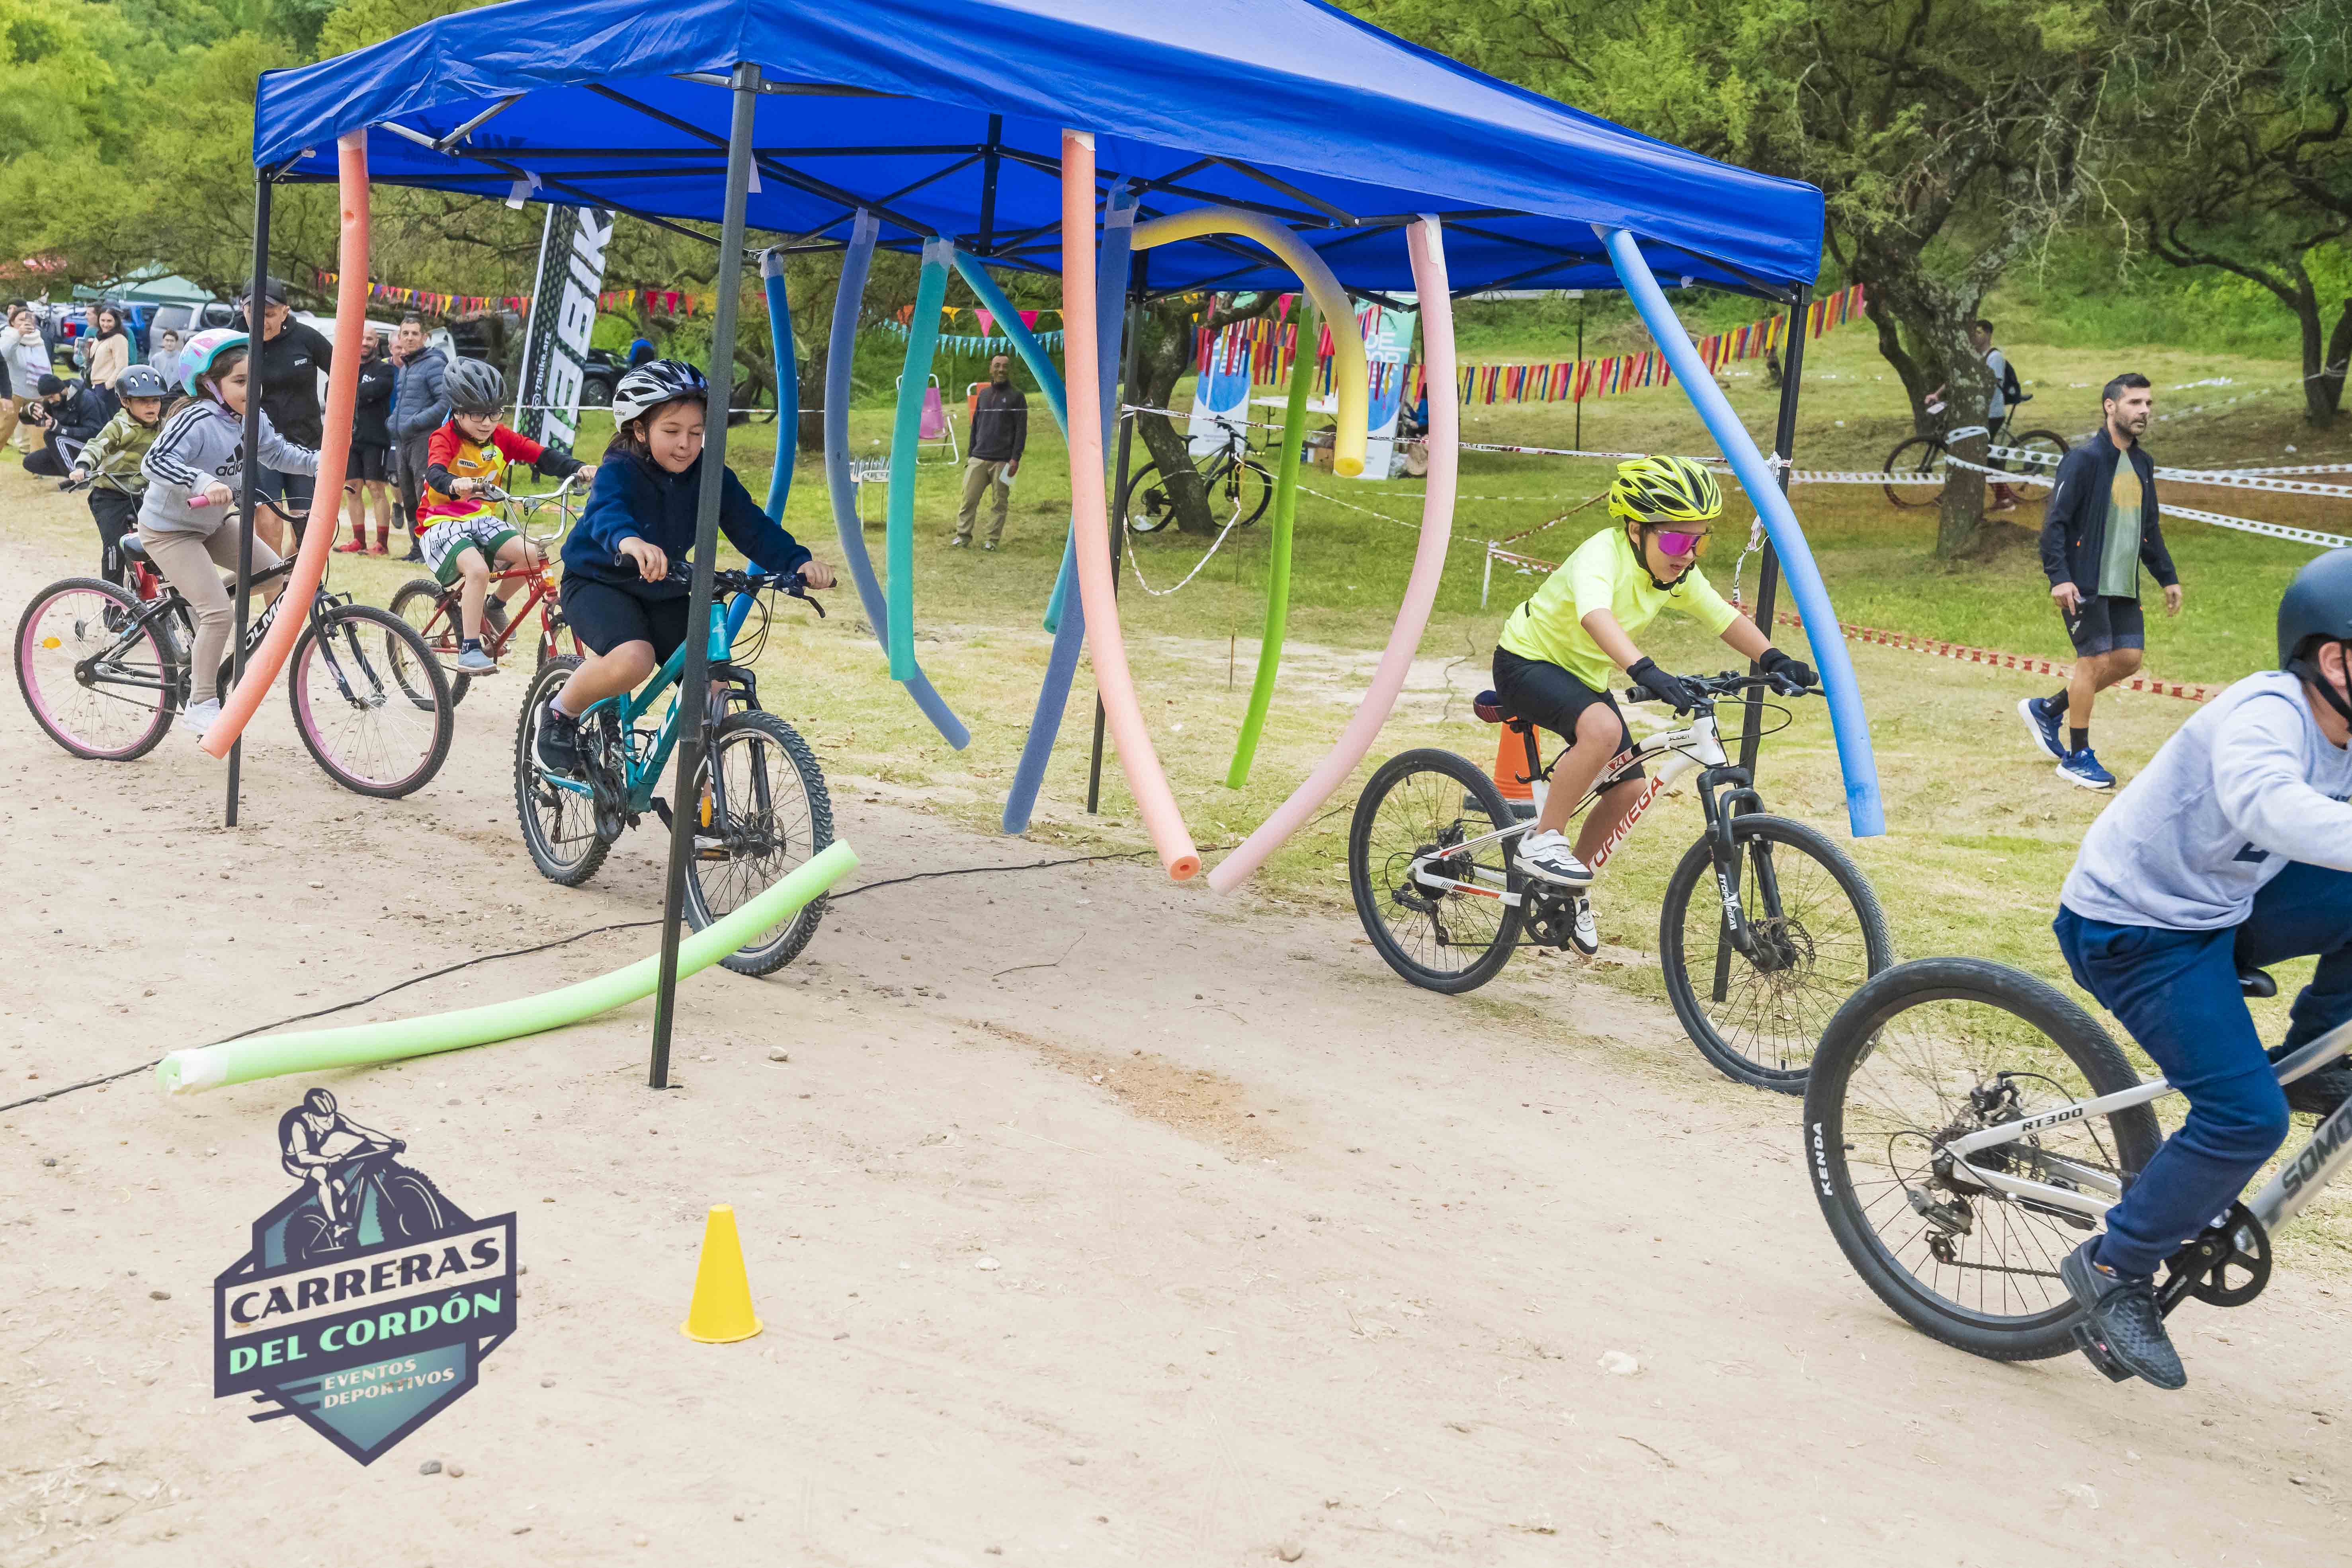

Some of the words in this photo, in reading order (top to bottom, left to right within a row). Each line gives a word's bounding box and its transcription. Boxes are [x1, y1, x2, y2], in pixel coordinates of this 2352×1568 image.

[539, 207, 616, 448] 73BIK
[2022, 1108, 2083, 1132] RT300
[1813, 1122, 1833, 1196] KENDA
